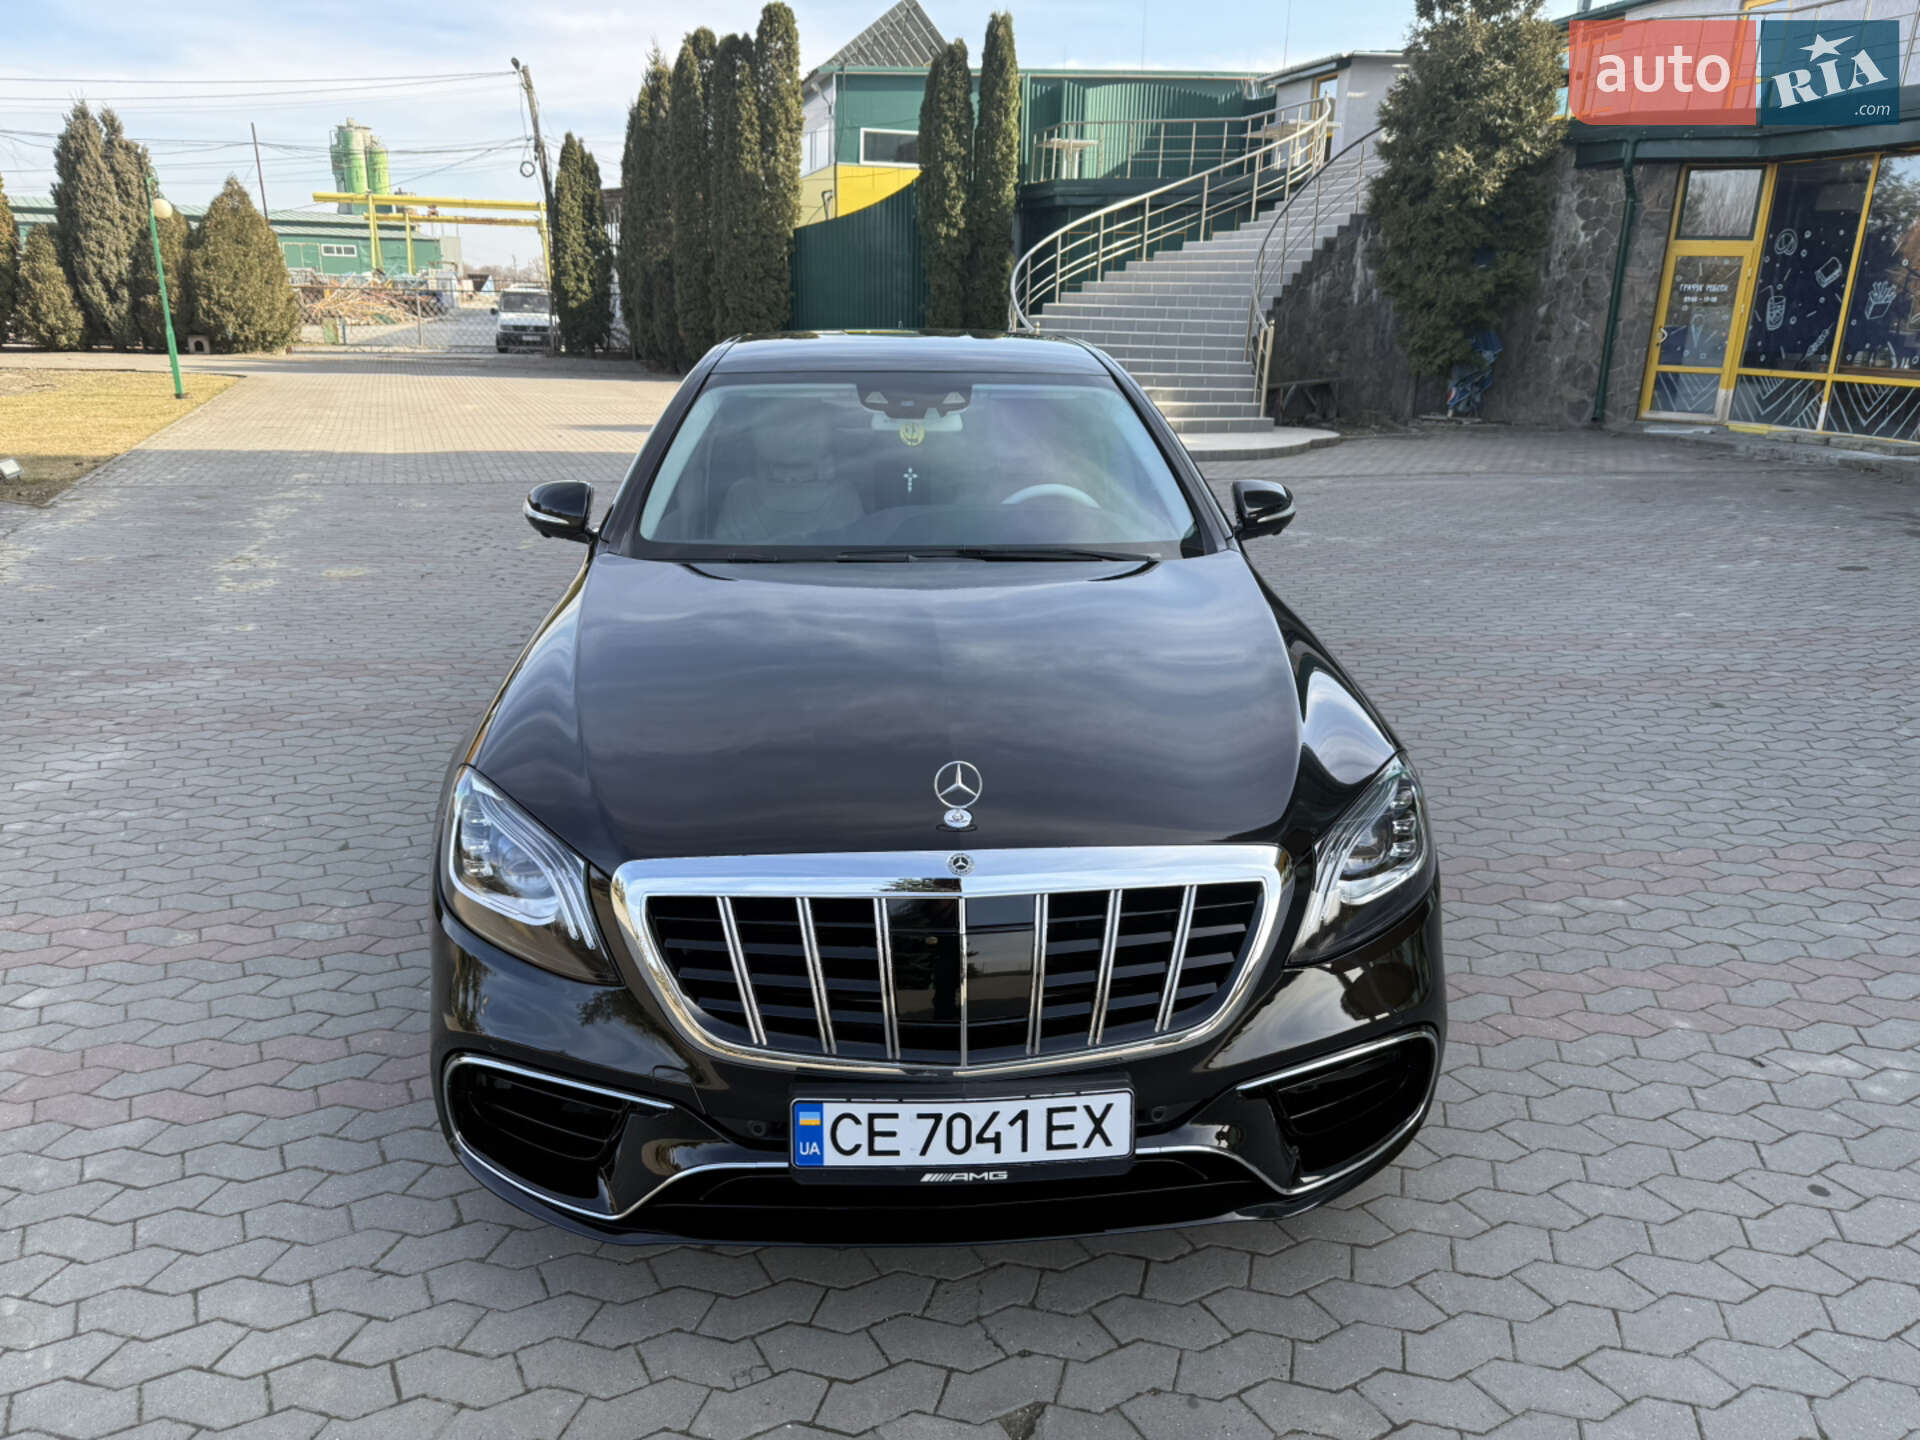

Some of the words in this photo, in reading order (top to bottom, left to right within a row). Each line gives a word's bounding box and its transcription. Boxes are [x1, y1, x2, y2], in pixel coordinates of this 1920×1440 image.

[830, 1112, 900, 1157] CE
[916, 1109, 1029, 1157] 7041
[1046, 1102, 1115, 1152] EX
[799, 1141, 821, 1156] UA
[949, 1171, 1009, 1182] AMG
